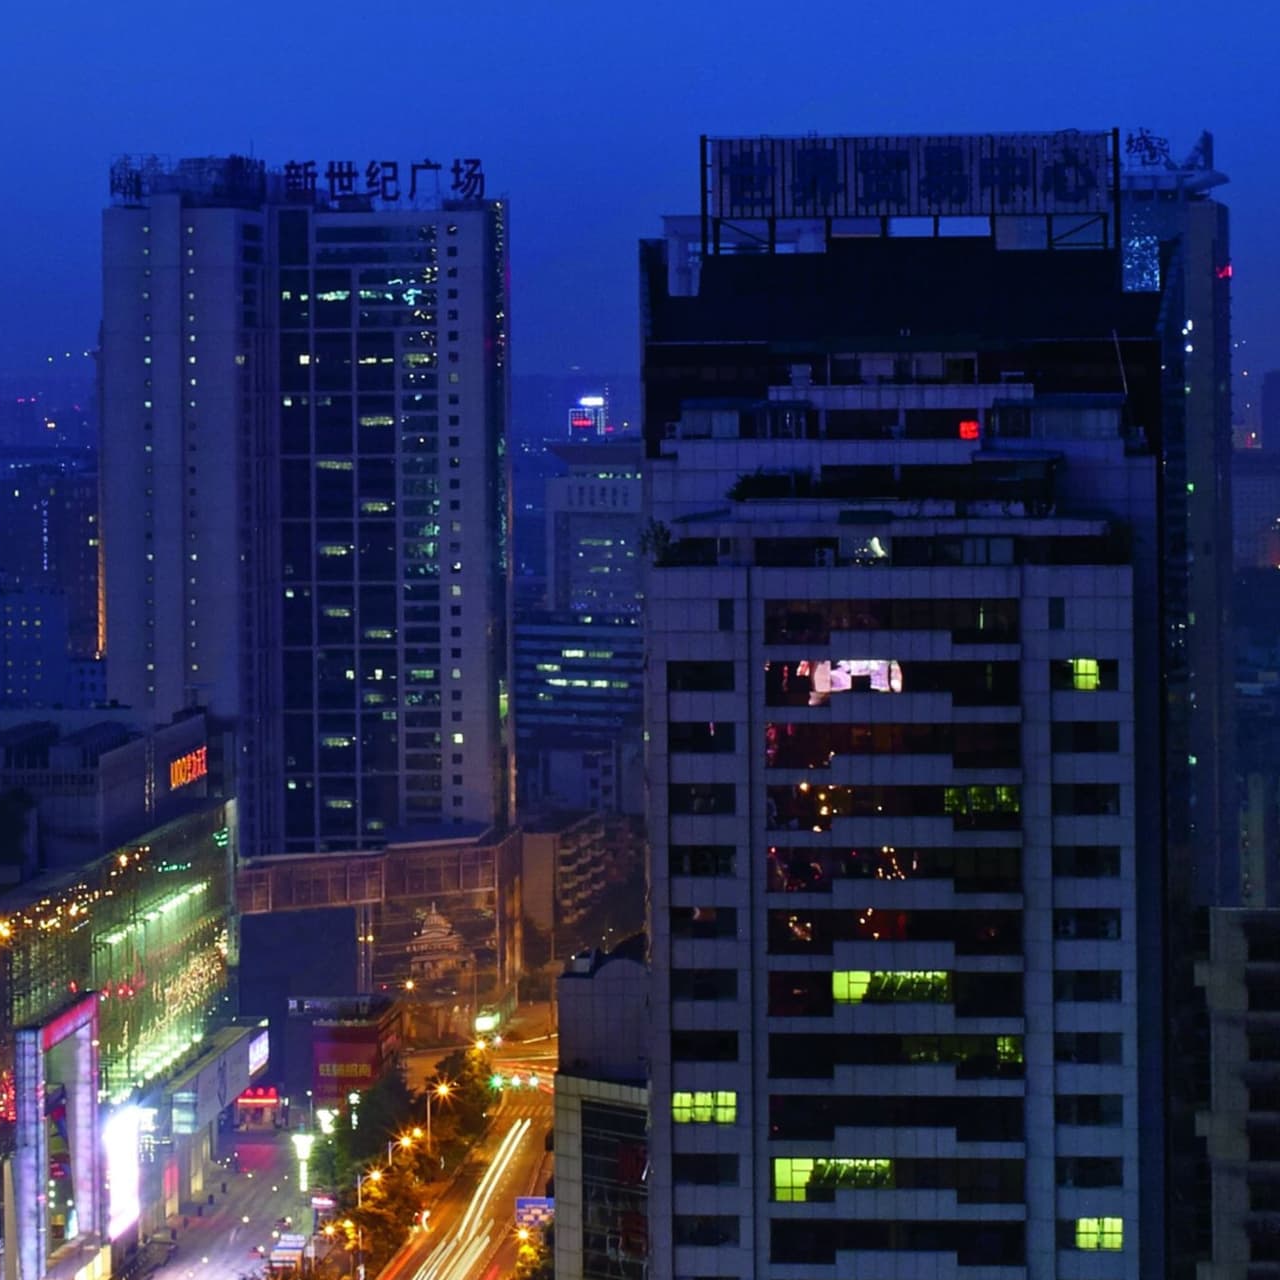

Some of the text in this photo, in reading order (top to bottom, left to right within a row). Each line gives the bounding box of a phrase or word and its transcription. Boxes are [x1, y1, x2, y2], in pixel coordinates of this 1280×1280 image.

[283, 158, 486, 202] 新世纪广场
